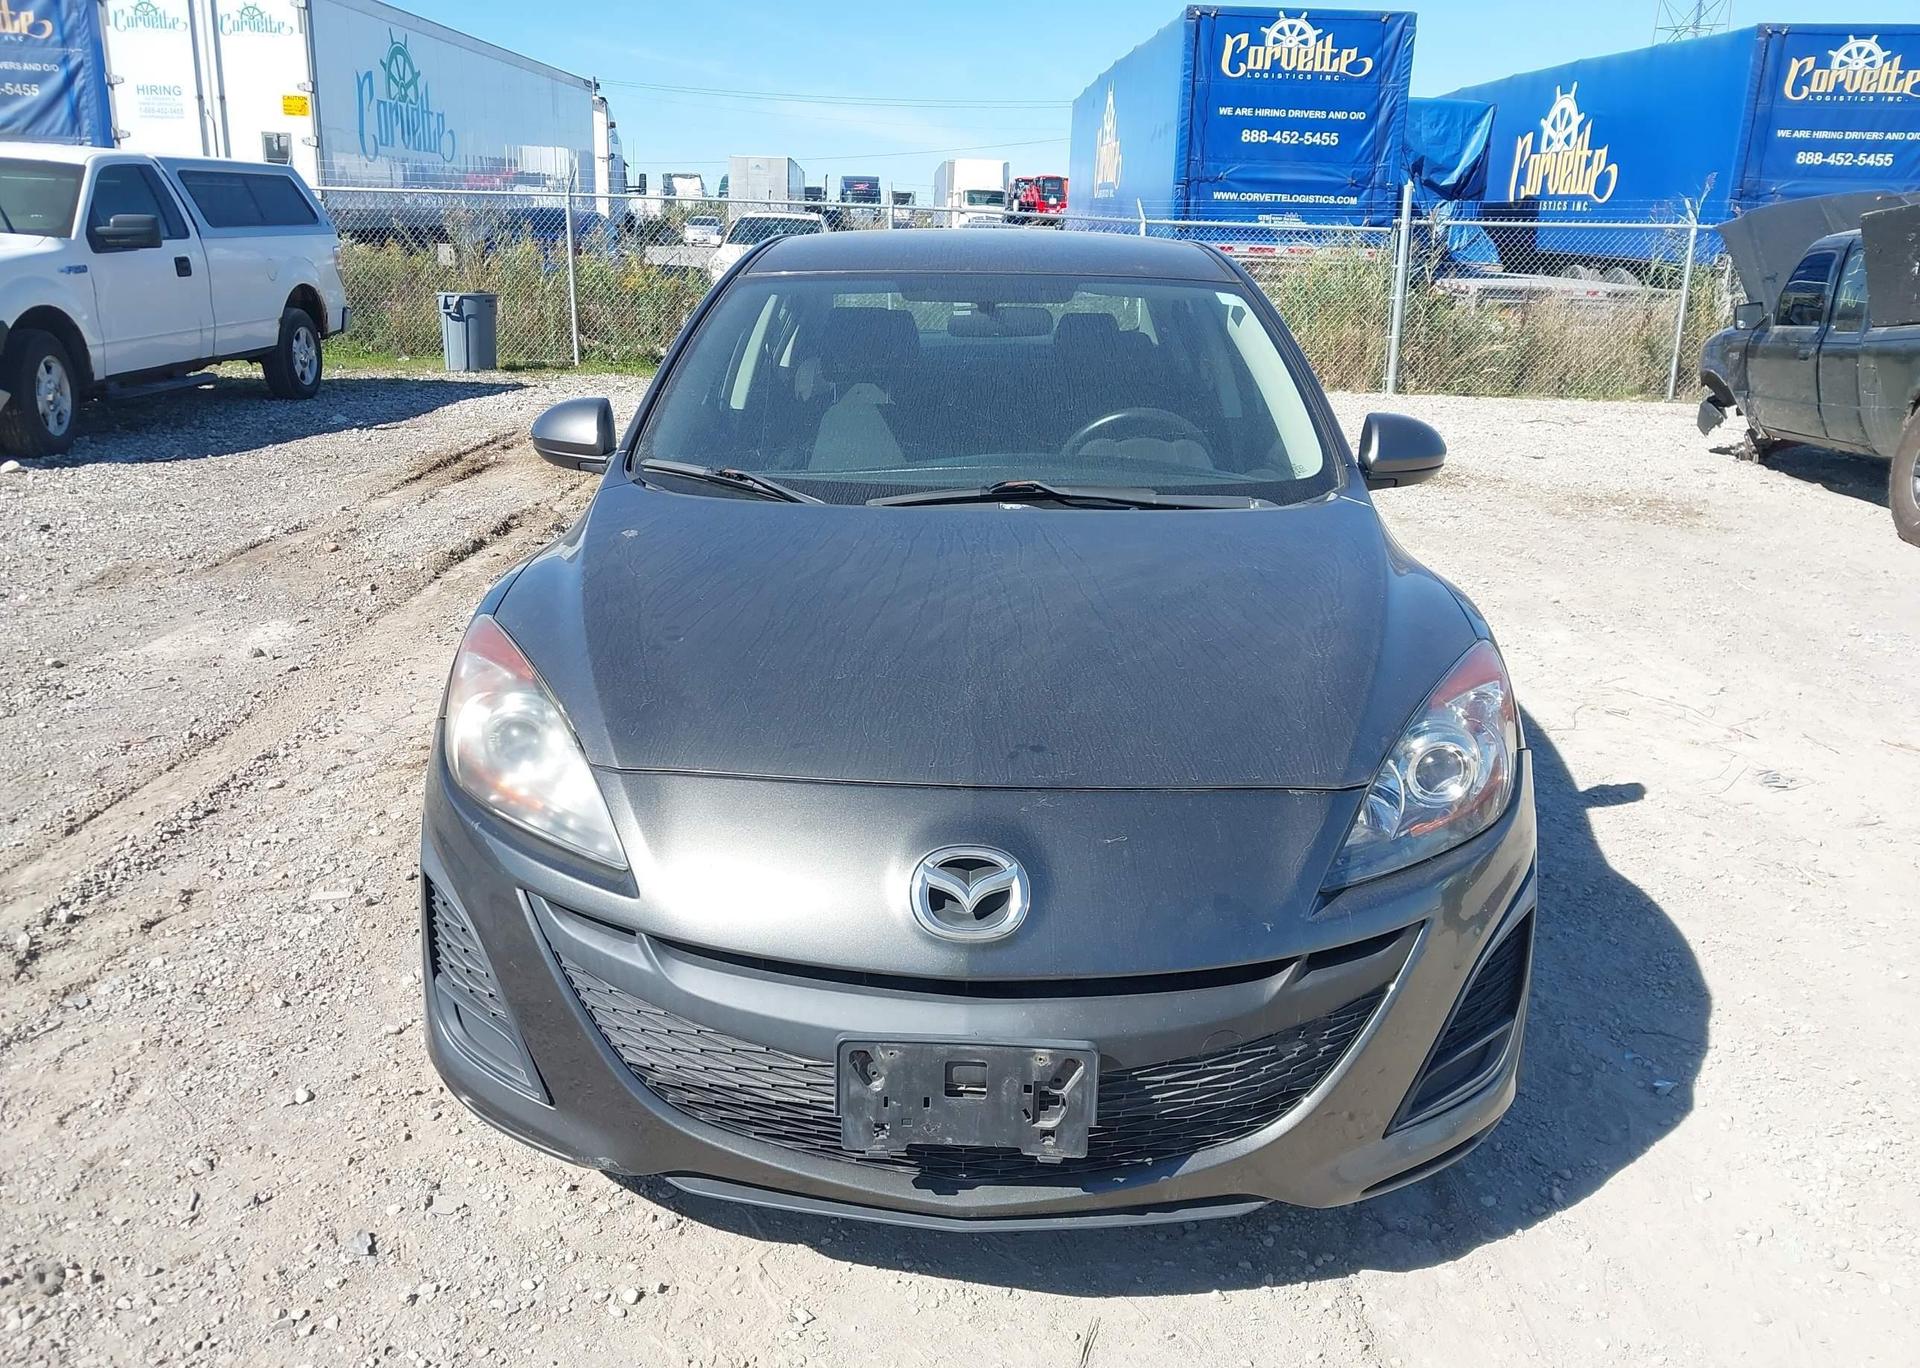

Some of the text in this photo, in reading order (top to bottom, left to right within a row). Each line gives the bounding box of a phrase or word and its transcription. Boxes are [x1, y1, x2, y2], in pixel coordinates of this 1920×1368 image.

[113, 8, 188, 32] Corvette
[219, 13, 294, 36] Corvette
[1221, 32, 1374, 78] Corvette
[23, 62, 42, 72] AND
[1246, 71, 1346, 82] LOGISTICS INC.
[1784, 54, 1920, 100] Corvette
[0, 82, 40, 97] -5455
[136, 83, 183, 96] HIRING
[1808, 94, 1875, 102] LOGISTICS
[355, 70, 456, 163] Corvette
[1218, 106, 1367, 121] WE ARE HIRING DRIVERS AND O/O
[1240, 128, 1340, 146] 888-452-5455
[1776, 128, 1792, 138] WE
[1792, 129, 1812, 139] ARE
[1812, 130, 1844, 140] HIRING
[1844, 130, 1885, 140] DRIVERS
[1885, 131, 1905, 140] AND
[1509, 118, 1619, 208] Corvette
[1795, 150, 1895, 167] 888-452-5455
[1212, 190, 1358, 206] WWW.CORVETTELOGISTICS.COM
[1572, 201, 1593, 212] INC.
